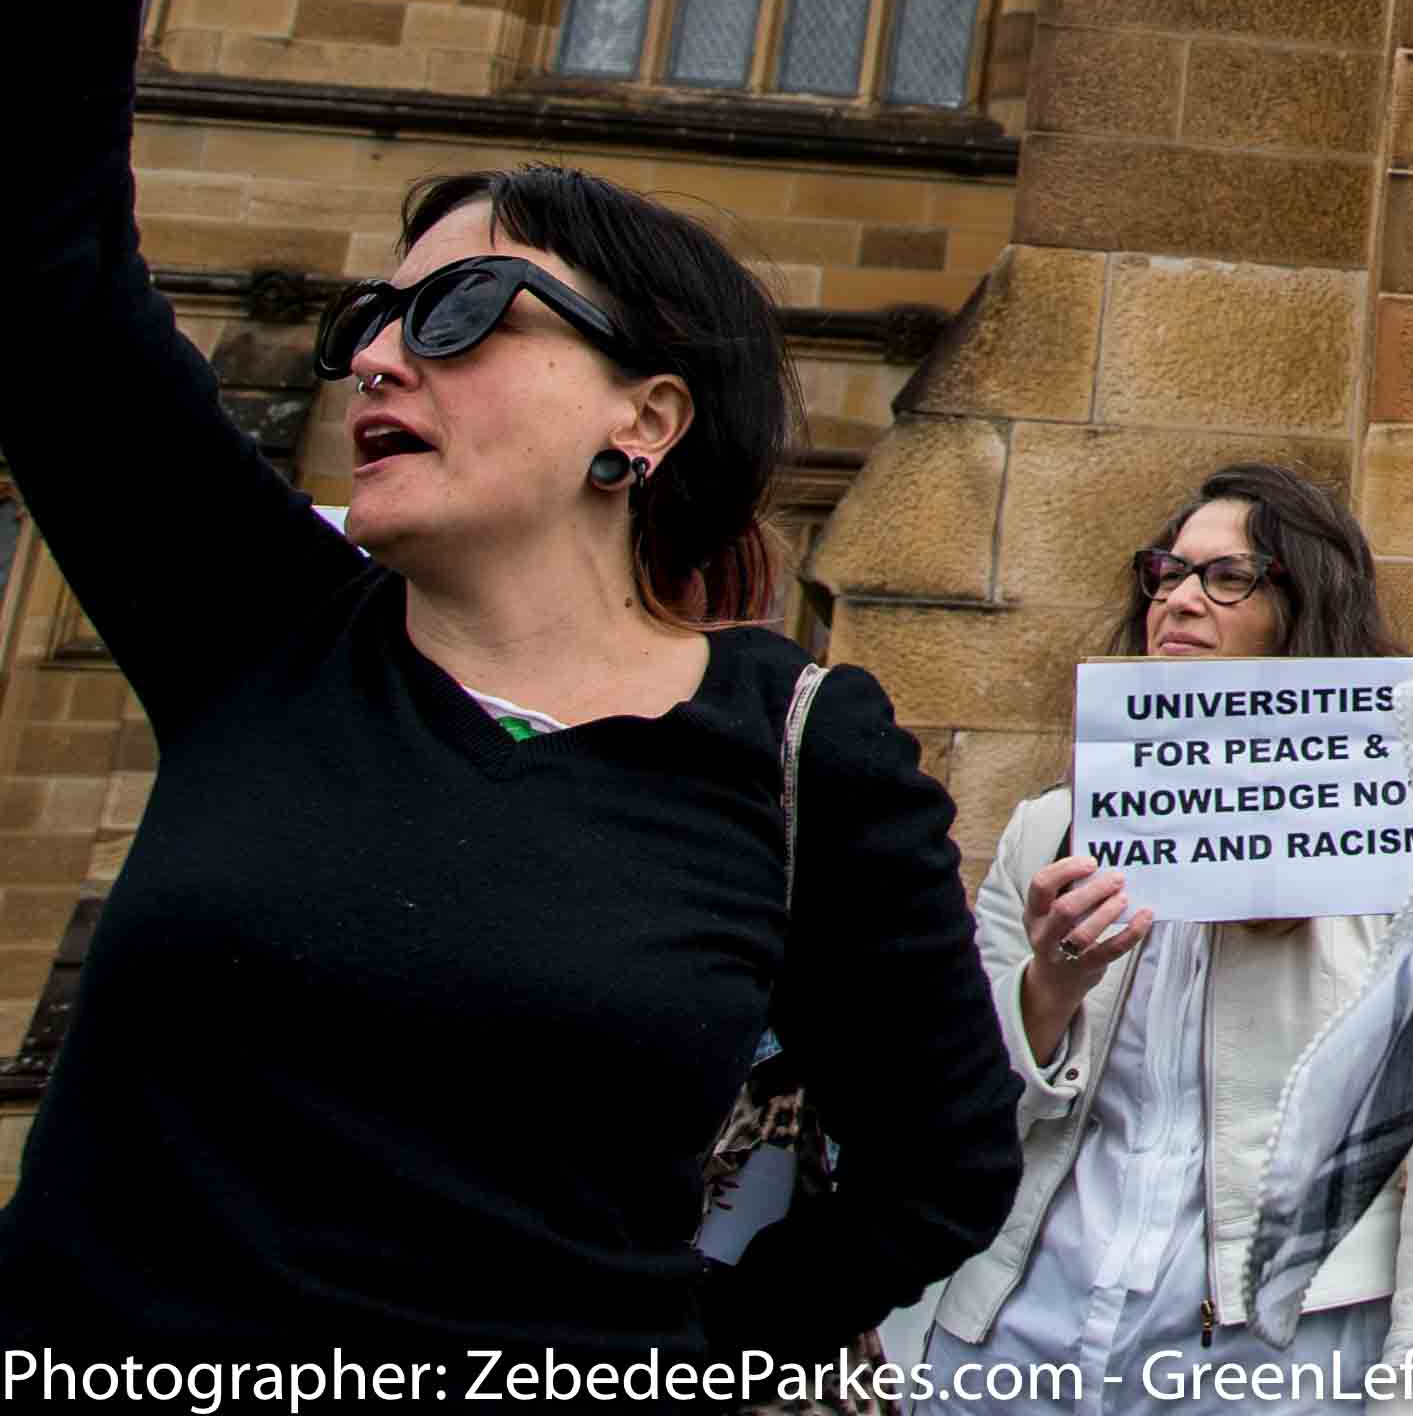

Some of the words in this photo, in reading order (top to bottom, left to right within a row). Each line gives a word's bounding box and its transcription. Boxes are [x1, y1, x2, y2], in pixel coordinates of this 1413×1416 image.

[1126, 686, 1395, 721] UNIVERSITIES
[1133, 740, 1212, 768] FOR
[1225, 735, 1350, 764] PEACE
[1363, 733, 1390, 759] &
[1091, 783, 1339, 818] KNOWLEDGE
[1353, 780, 1410, 808] NO
[1088, 838, 1178, 868] WAR
[1191, 835, 1273, 863] AND
